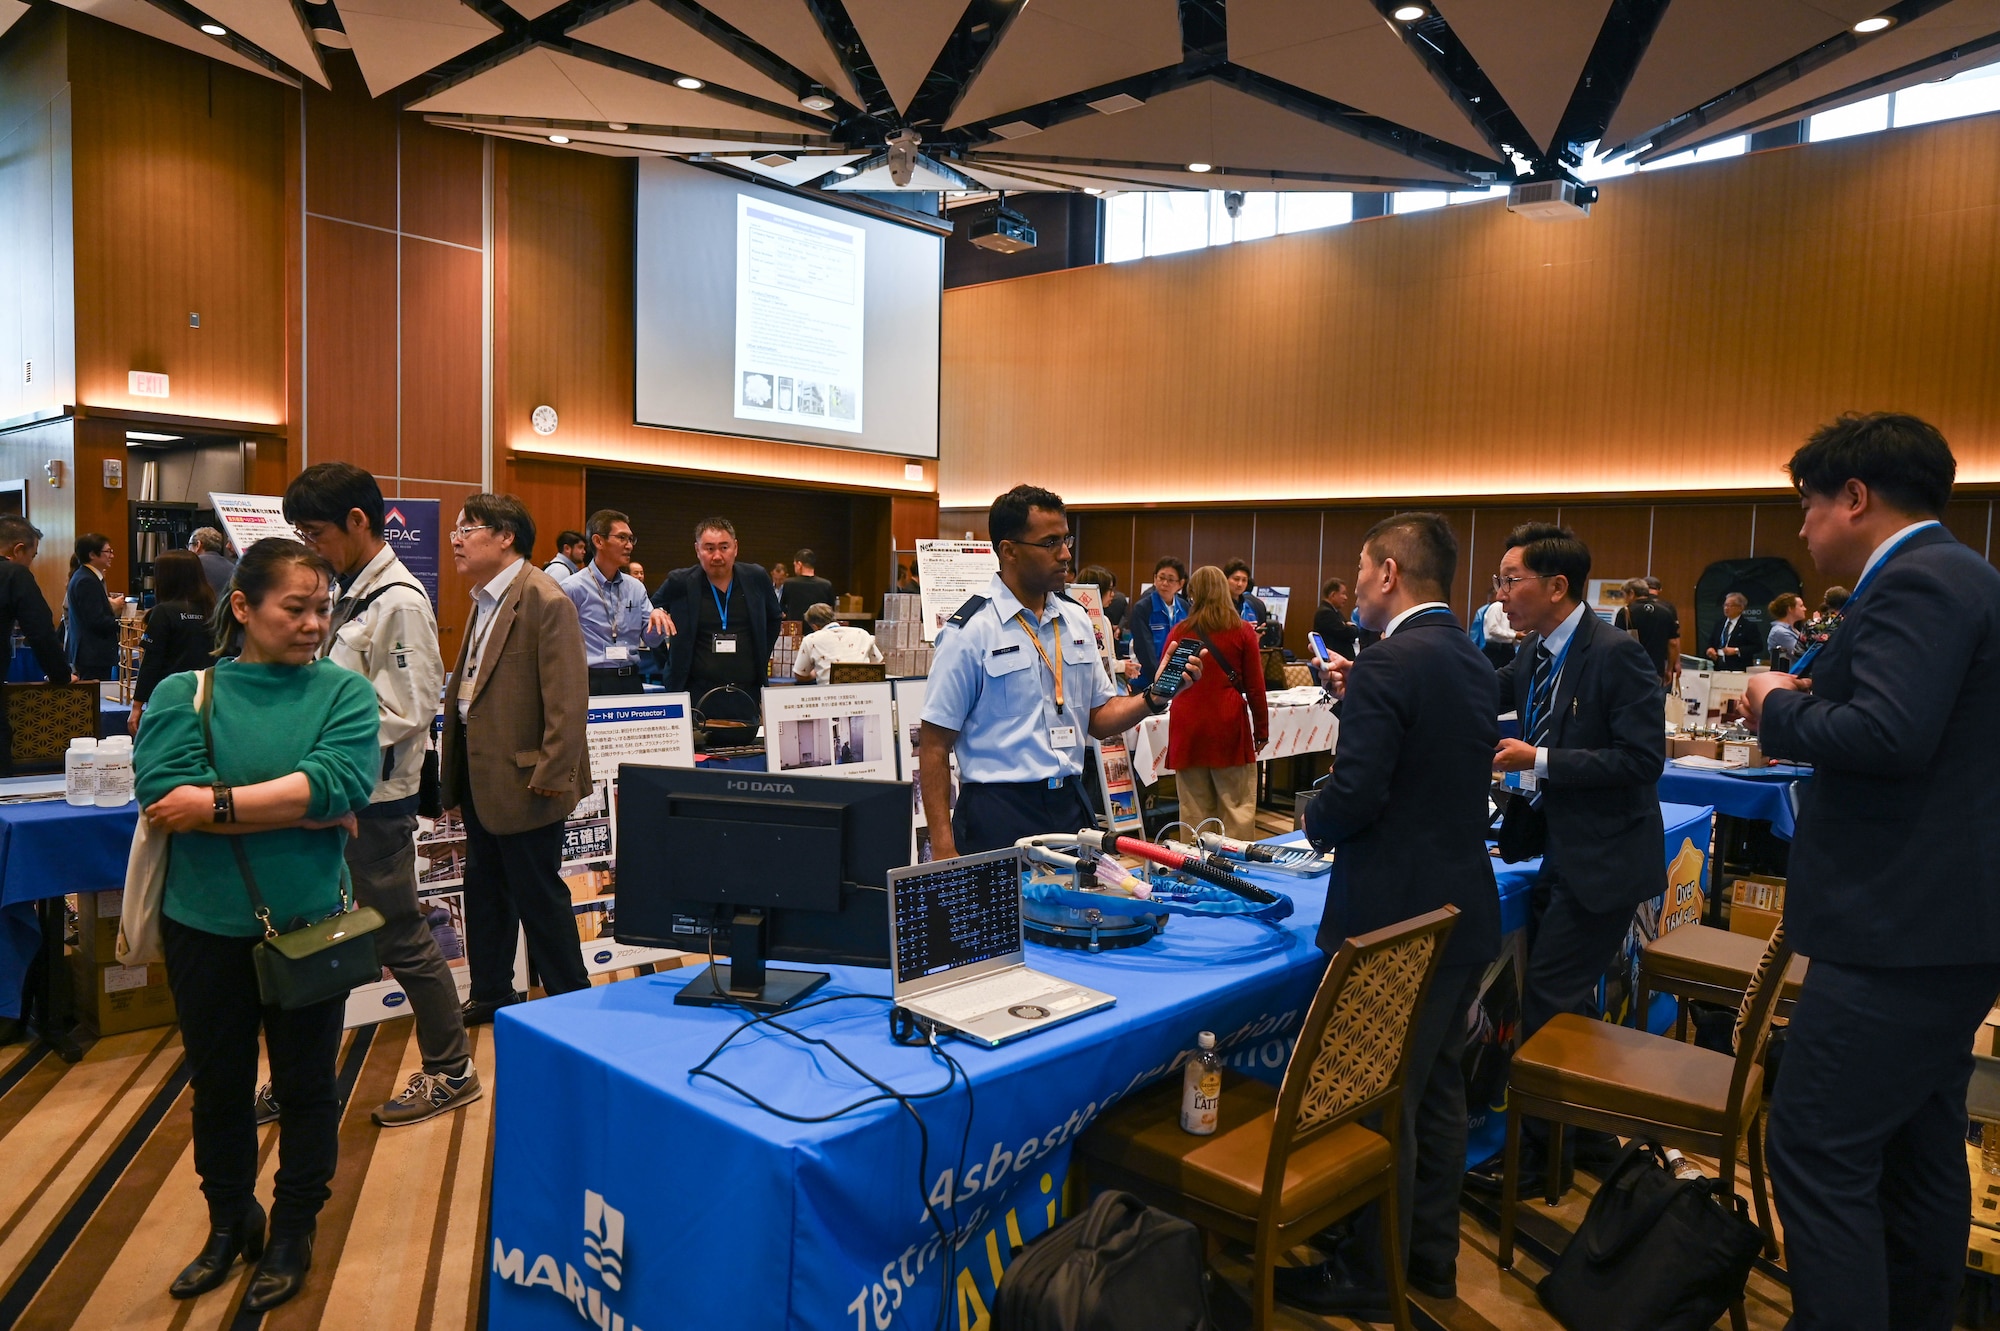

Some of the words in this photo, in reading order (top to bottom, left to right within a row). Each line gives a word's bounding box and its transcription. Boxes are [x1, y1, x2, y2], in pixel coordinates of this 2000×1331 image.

[137, 374, 164, 394] EXIT
[751, 782, 795, 793] DATA
[1676, 881, 1695, 906] Over
